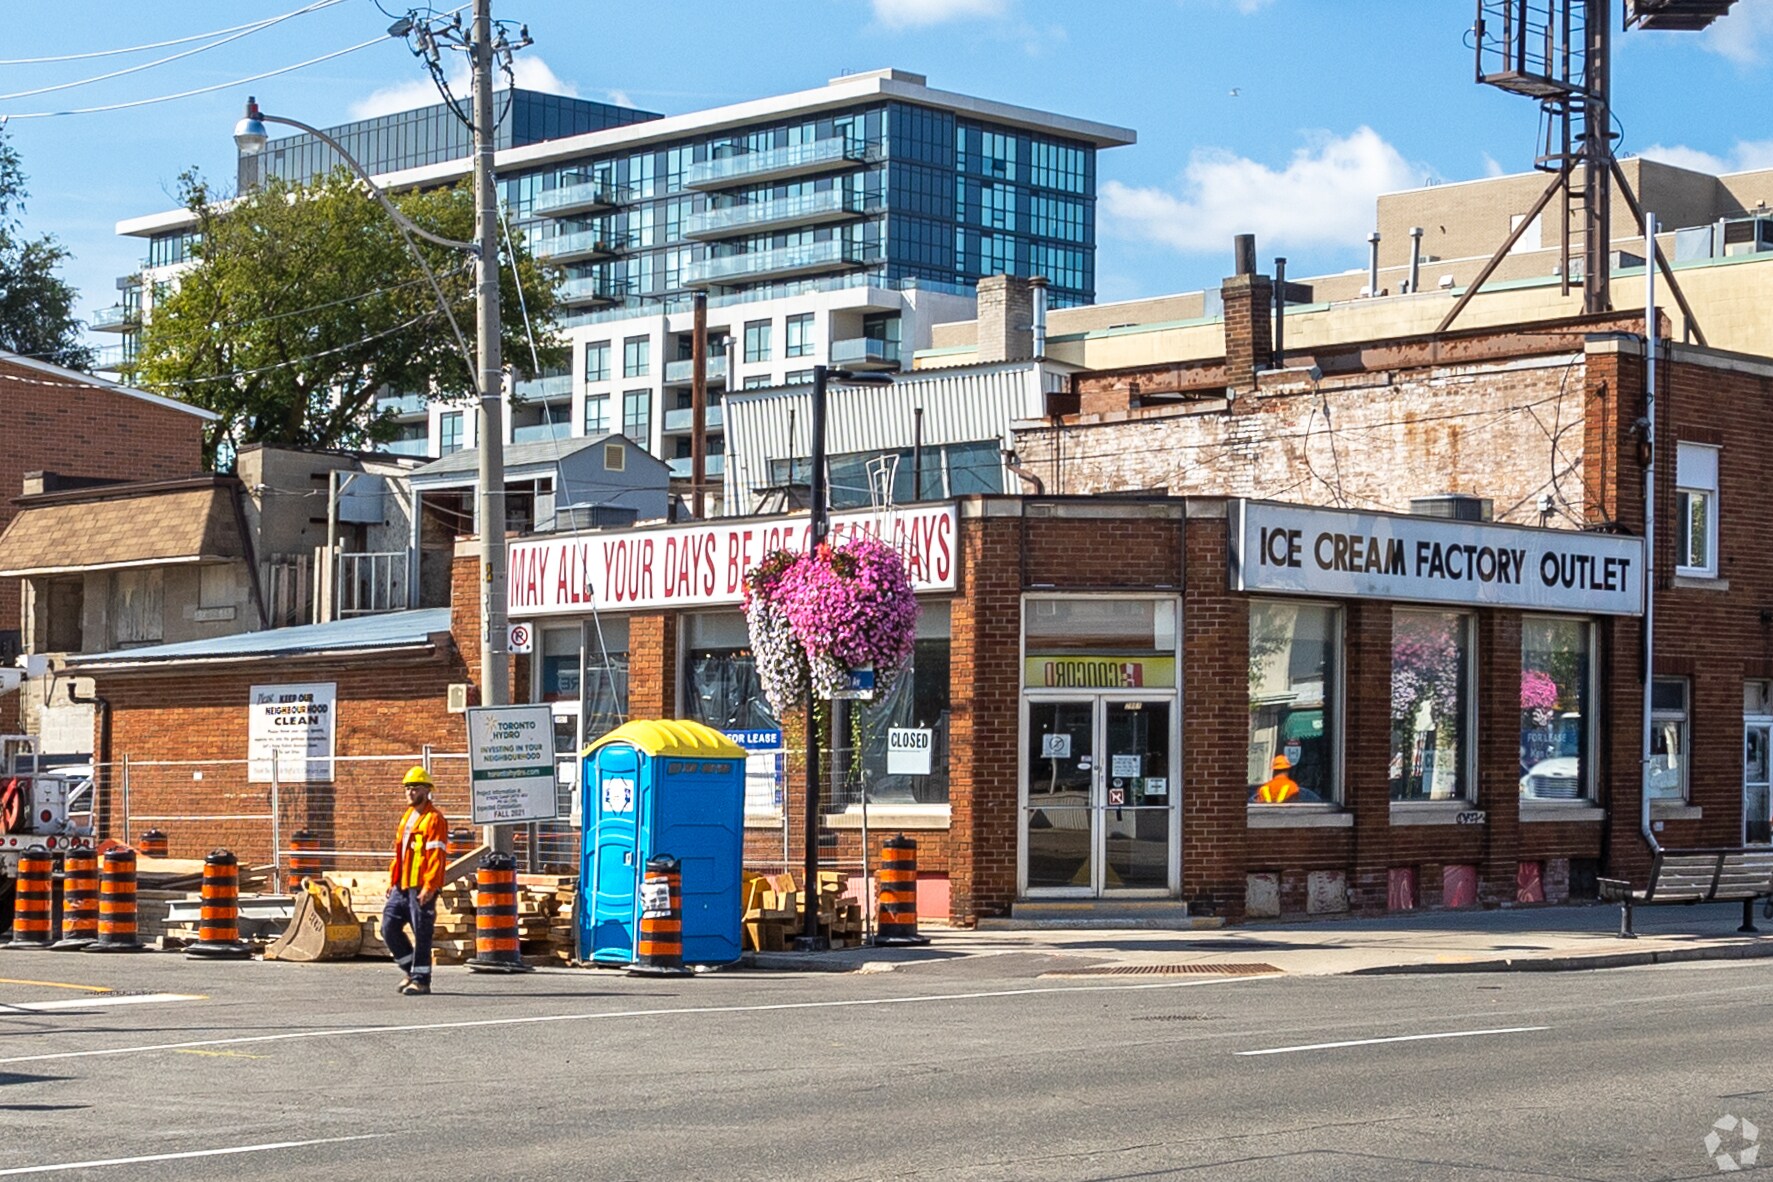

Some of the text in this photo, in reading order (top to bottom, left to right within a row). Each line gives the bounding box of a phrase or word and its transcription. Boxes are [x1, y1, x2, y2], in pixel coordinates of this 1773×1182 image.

[1260, 527, 1630, 592] ICE CREAM FACTORY OUTLET
[511, 546, 549, 607] MAY
[556, 543, 592, 604] ALL
[603, 539, 654, 602] YOUR
[664, 532, 716, 598] DAYS
[727, 530, 753, 593] BE
[279, 694, 297, 704] KEEP
[298, 693, 314, 703] OUR
[274, 715, 319, 725] CLEAN
[498, 721, 536, 731] TORONTO
[492, 730, 521, 740] HYDRO
[747, 733, 777, 744] LEASE
[891, 732, 928, 749] CLOSED
[480, 743, 543, 754] INVESTING IN YOUR
[484, 752, 541, 763] NEIGHBOURHOOD
[493, 810, 509, 818] FALL
